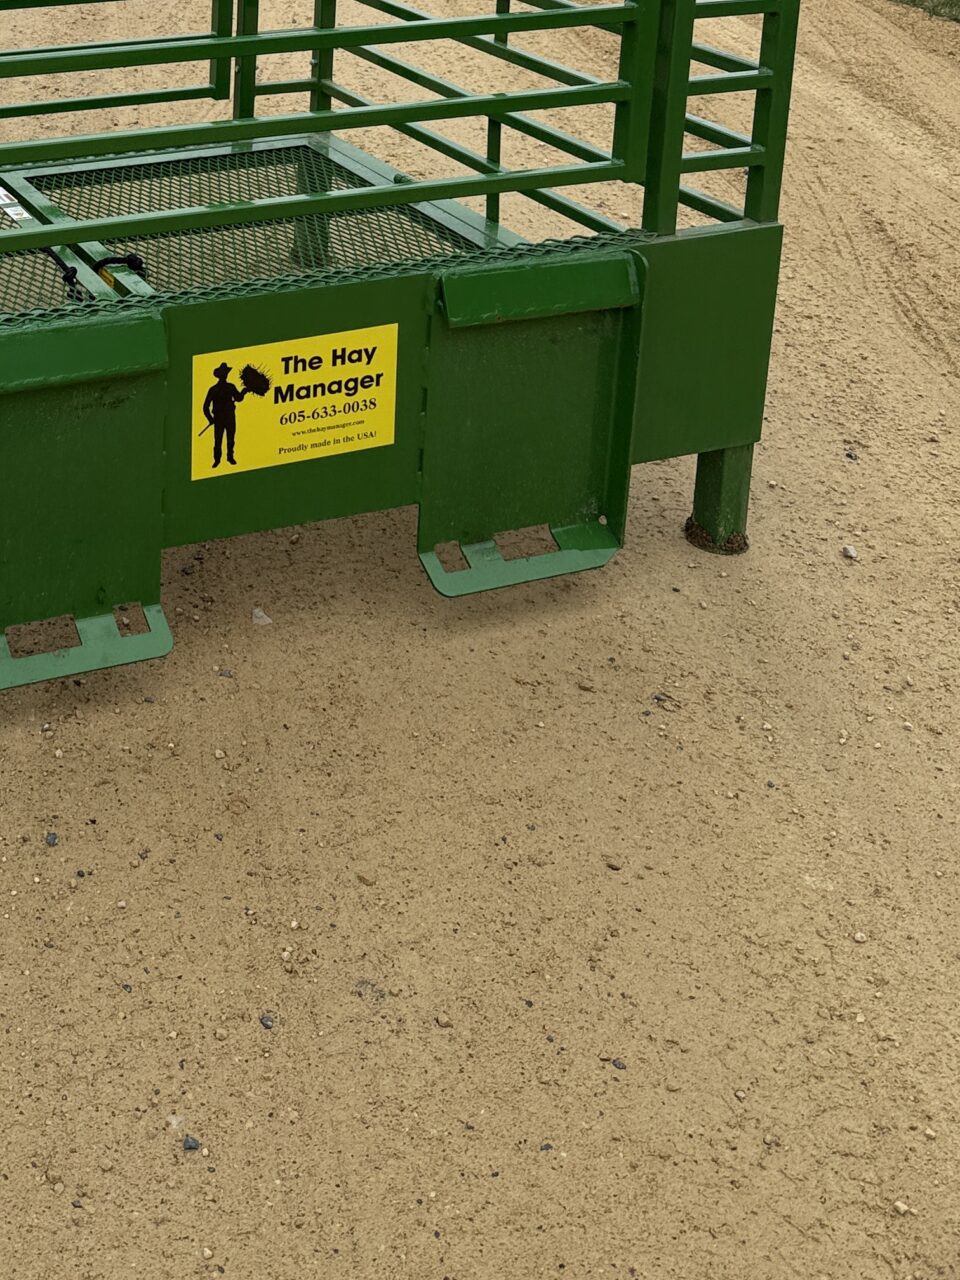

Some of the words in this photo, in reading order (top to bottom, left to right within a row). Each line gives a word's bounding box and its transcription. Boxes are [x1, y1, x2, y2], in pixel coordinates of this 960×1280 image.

[281, 355, 323, 375] The
[331, 346, 377, 367] Hay
[273, 372, 384, 404] Manager
[279, 398, 377, 426] 605-633-0038
[291, 419, 365, 436] www.thehaymanager.com
[278, 442, 309, 455] Proudly
[310, 439, 332, 449] made
[333, 437, 341, 445] in
[342, 434, 355, 444] the
[357, 431, 377, 441] USA!
